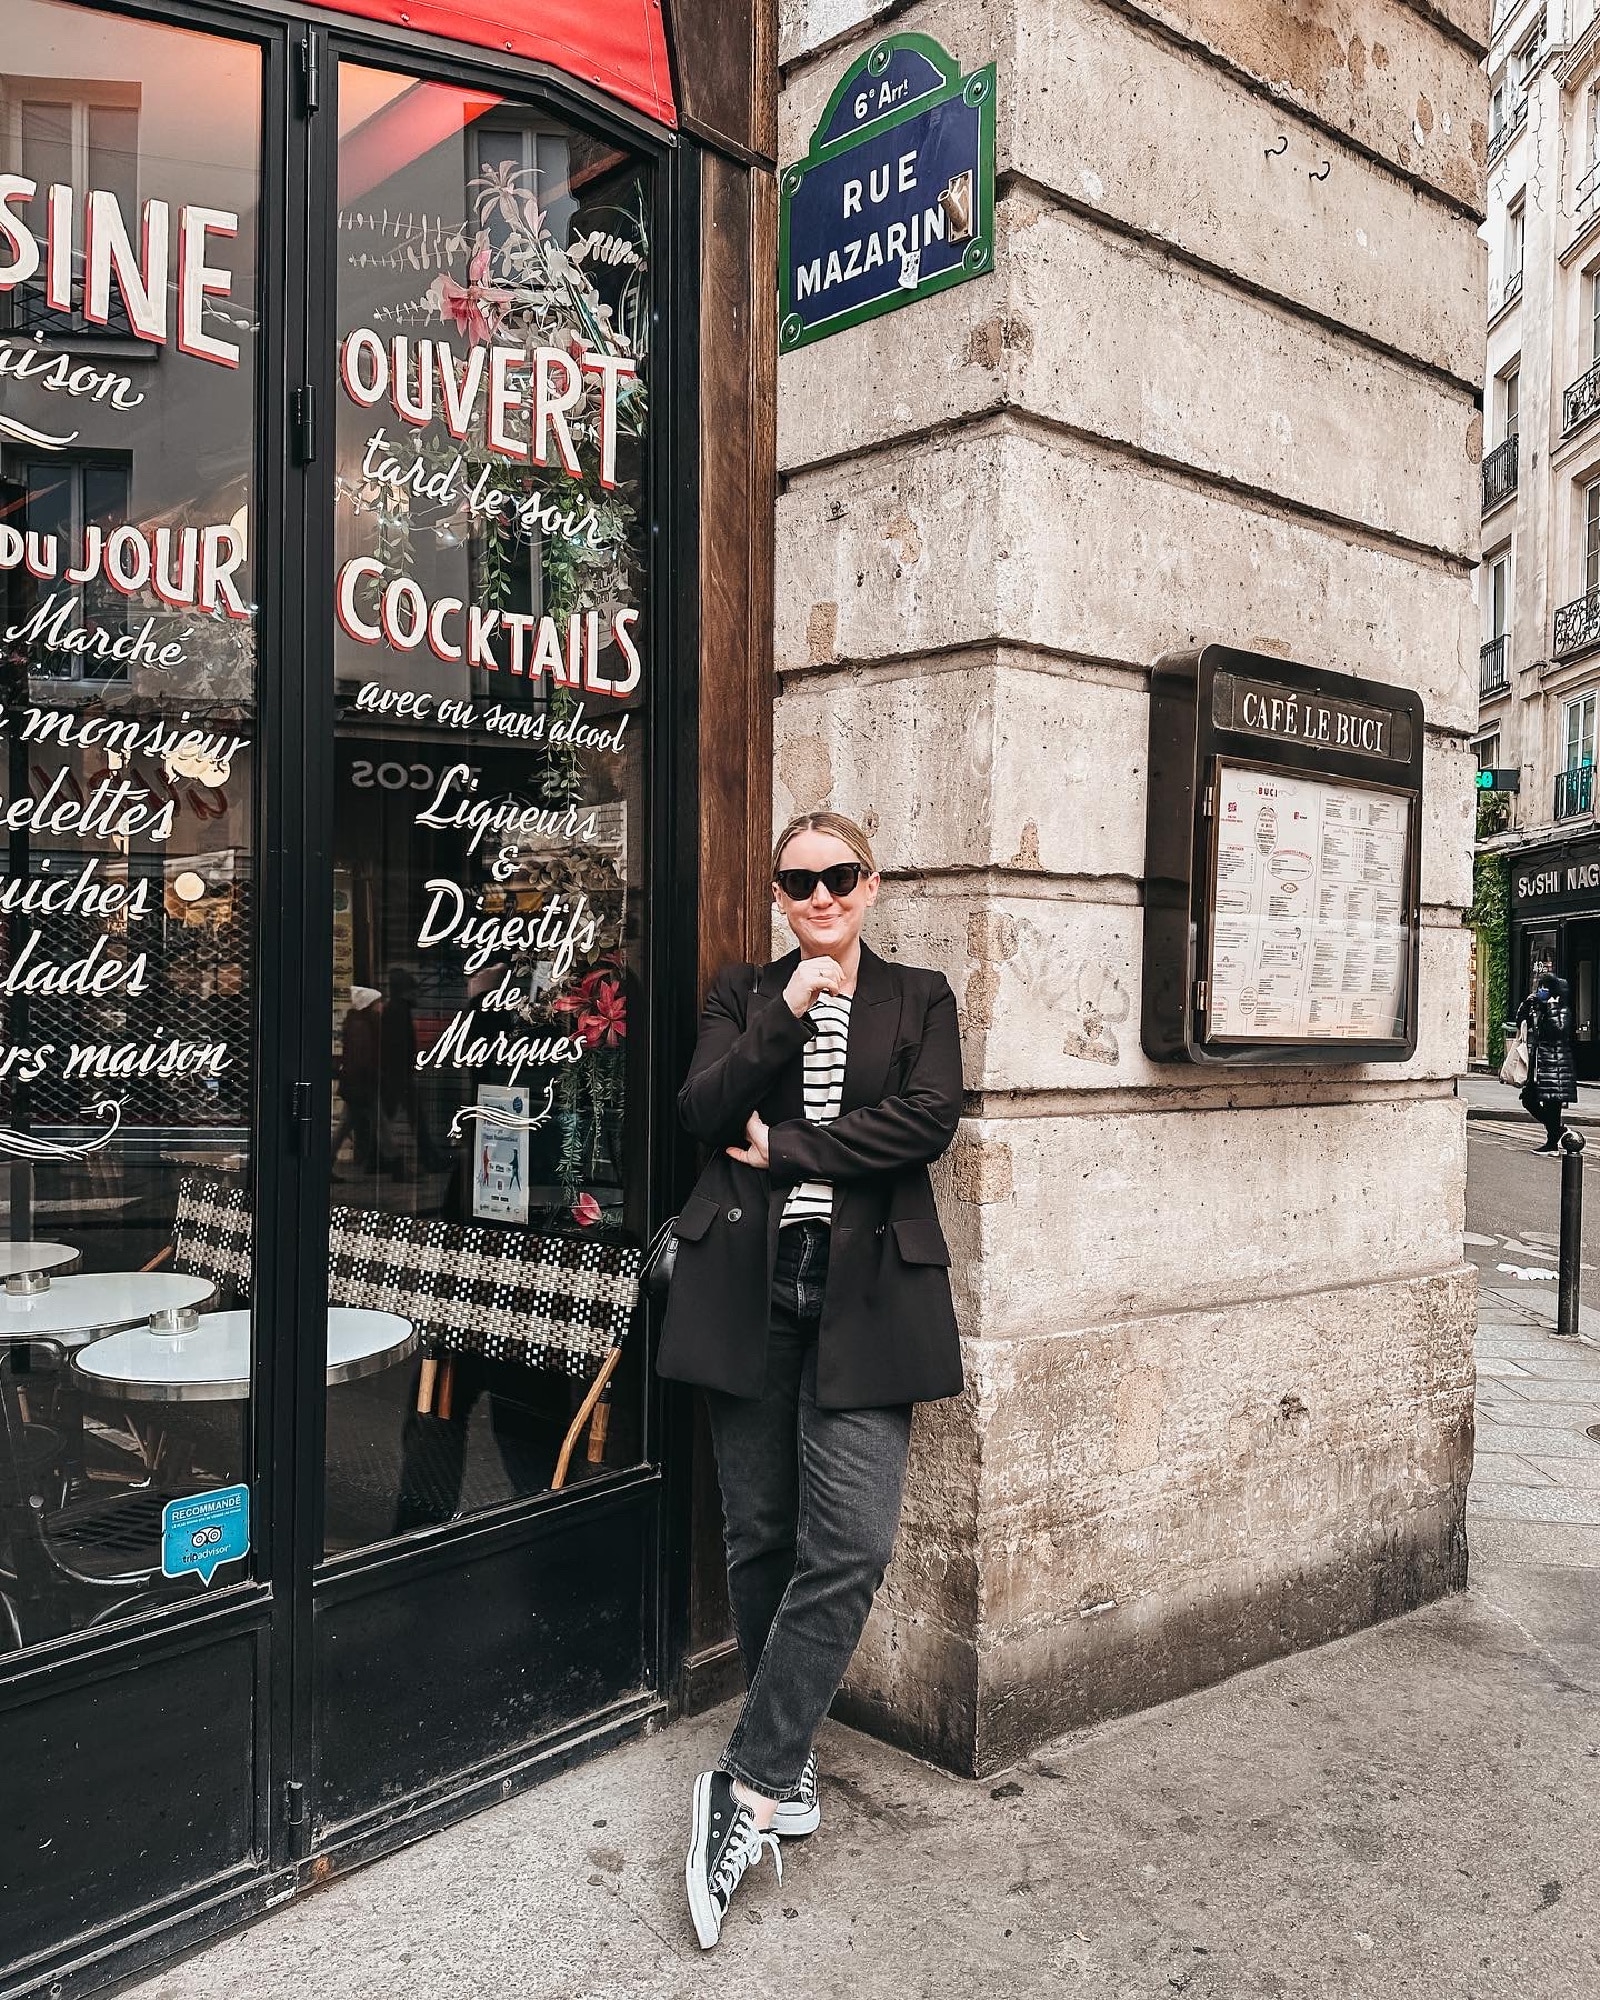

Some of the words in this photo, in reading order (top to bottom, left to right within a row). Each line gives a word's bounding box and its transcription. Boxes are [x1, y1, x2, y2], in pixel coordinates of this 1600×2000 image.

[843, 150, 918, 219] RUE
[797, 202, 945, 301] MAZARIN
[340, 327, 638, 491] OUVERT
[362, 428, 459, 505] tard
[469, 464, 503, 516] le
[518, 492, 603, 547] soir
[0, 523, 57, 579] DU
[65, 524, 250, 619] JOUR
[3, 593, 195, 670] Marché
[336, 557, 641, 698] COCKTAILS
[20, 708, 251, 763] monsieur
[355, 681, 434, 720] avec
[437, 698, 479, 729] ou
[483, 703, 547, 738] sans
[549, 701, 630, 754] alcool
[1243, 693, 1299, 735] CAFÉ
[1303, 706, 1331, 742] LE
[1336, 712, 1383, 752] BUCI
[0, 766, 175, 842] elettes
[414, 763, 598, 857] Liqueurs
[491, 846, 521, 881] &
[417, 879, 604, 982] Digestifs
[482, 970, 523, 1012] de
[0, 1044, 55, 1082] rs
[63, 1027, 234, 1079] maison
[414, 1009, 588, 1090] Marques
[172, 1494, 241, 1521] RECOMMANDÉ
